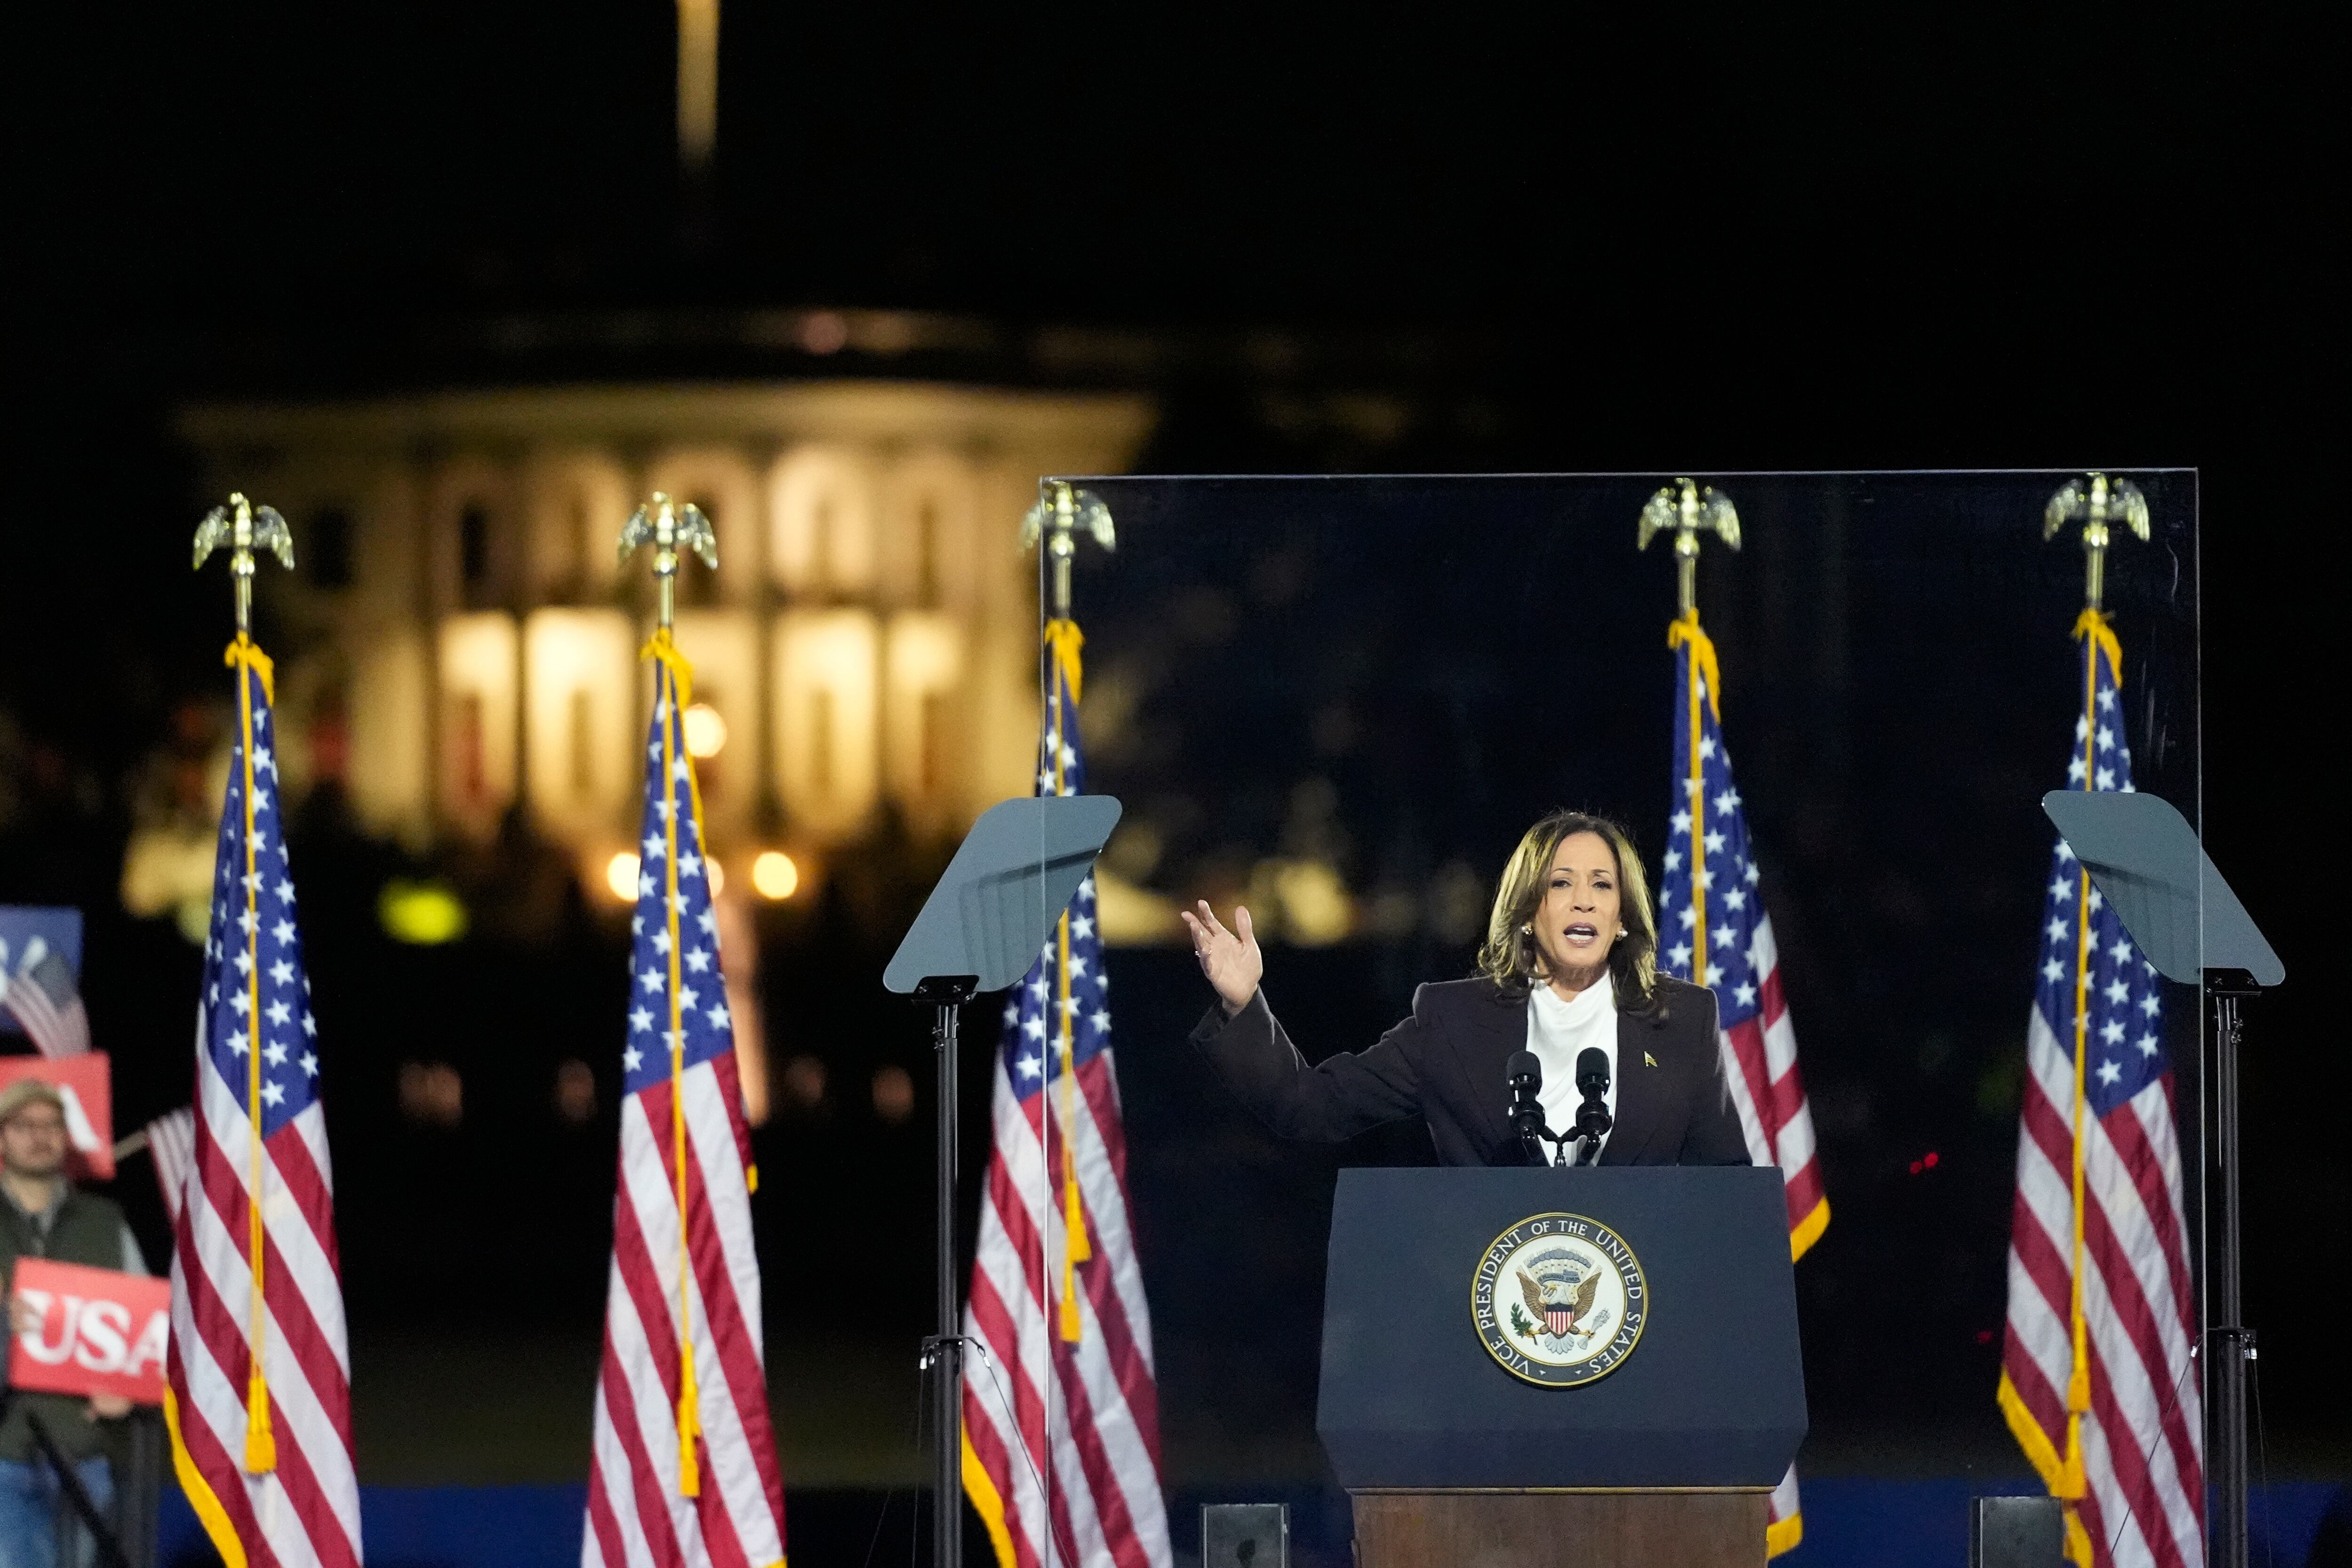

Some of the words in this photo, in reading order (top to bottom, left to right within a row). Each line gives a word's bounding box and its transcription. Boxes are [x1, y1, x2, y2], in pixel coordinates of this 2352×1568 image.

[1531, 1221, 1550, 1235] OF
[1557, 1220, 1588, 1236] THE
[1477, 1229, 1522, 1329] PRESIDENT
[1595, 1229, 1642, 1300] UNITED
[19, 1288, 170, 1380] USA
[1490, 1335, 1529, 1375] VICE
[1589, 1311, 1642, 1374] STATES
